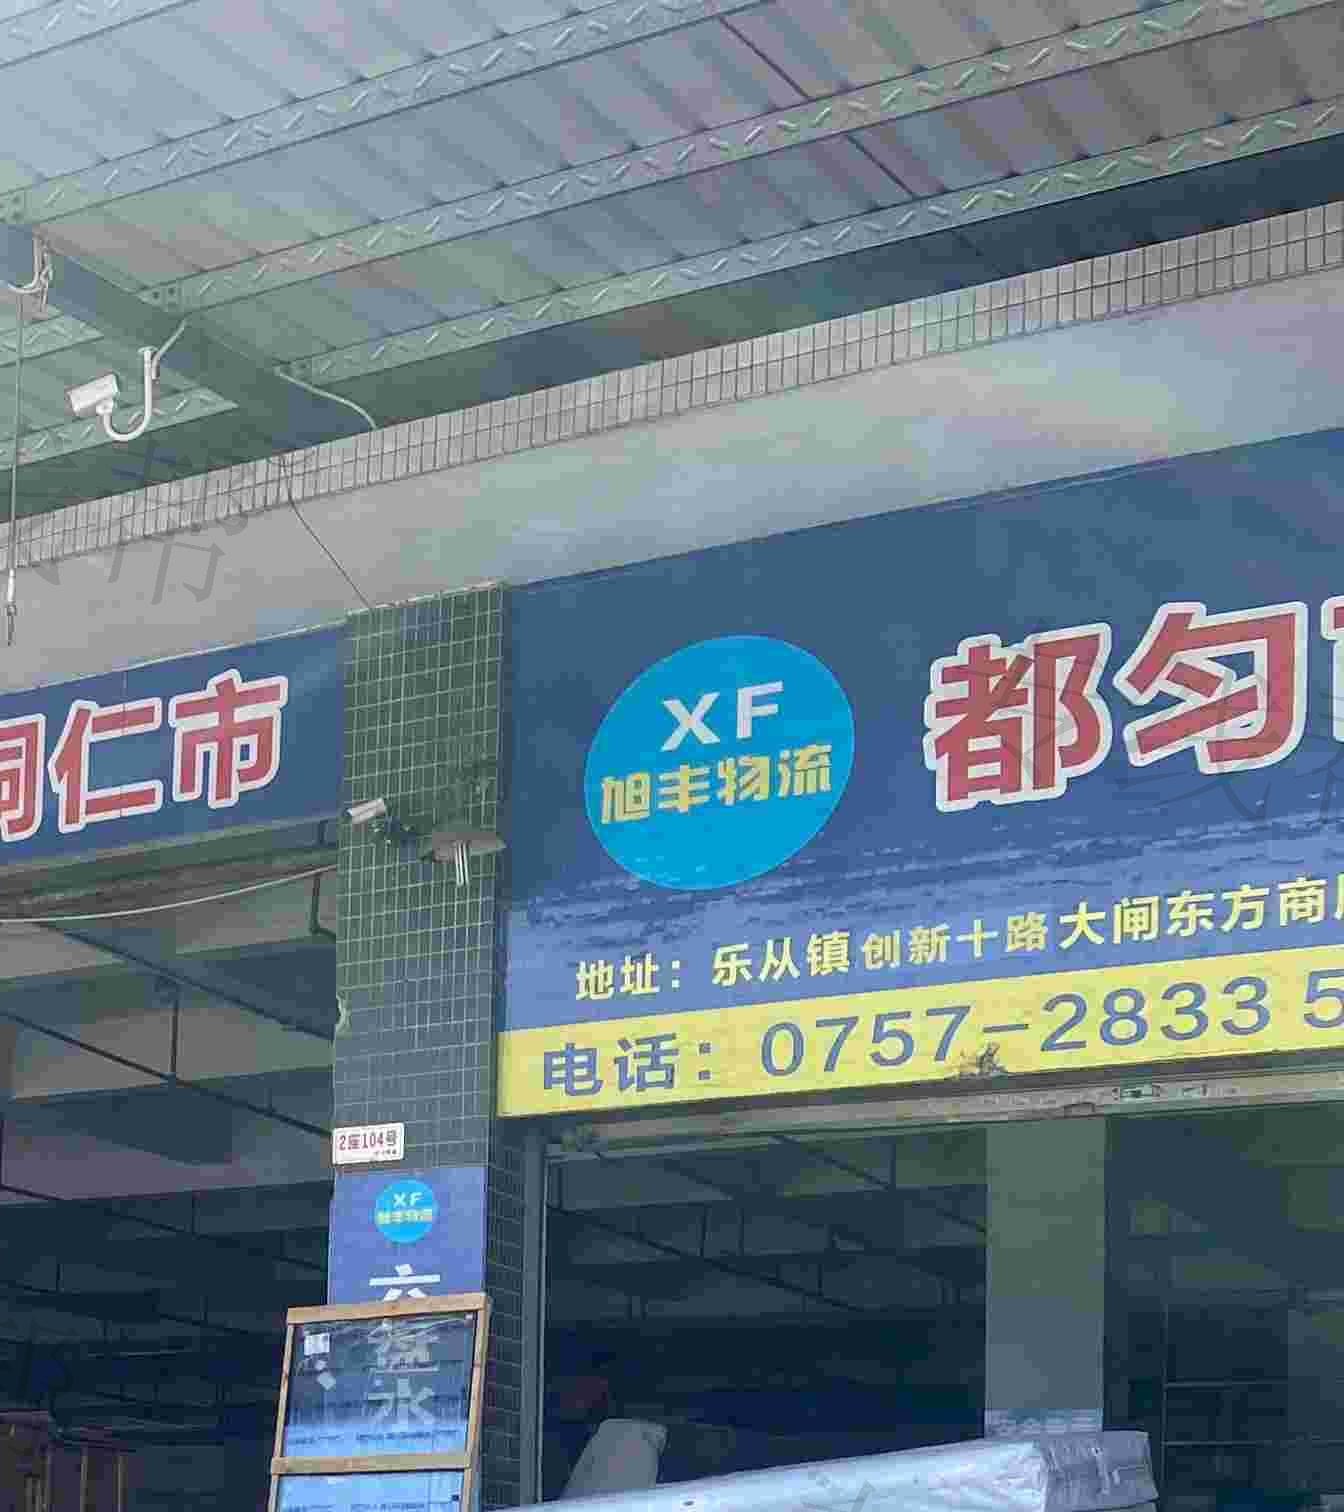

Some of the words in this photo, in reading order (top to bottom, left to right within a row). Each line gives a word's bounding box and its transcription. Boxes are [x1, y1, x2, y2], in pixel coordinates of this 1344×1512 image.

[660, 680, 786, 752] XF
[923, 596, 1344, 813] 都匀
[600, 742, 834, 825] 旭丰物流
[575, 872, 1344, 1003] 地址：乐从镇创新十路大闸东方商
[338, 1128, 400, 1151] 2座104号
[393, 1192, 423, 1208] XF
